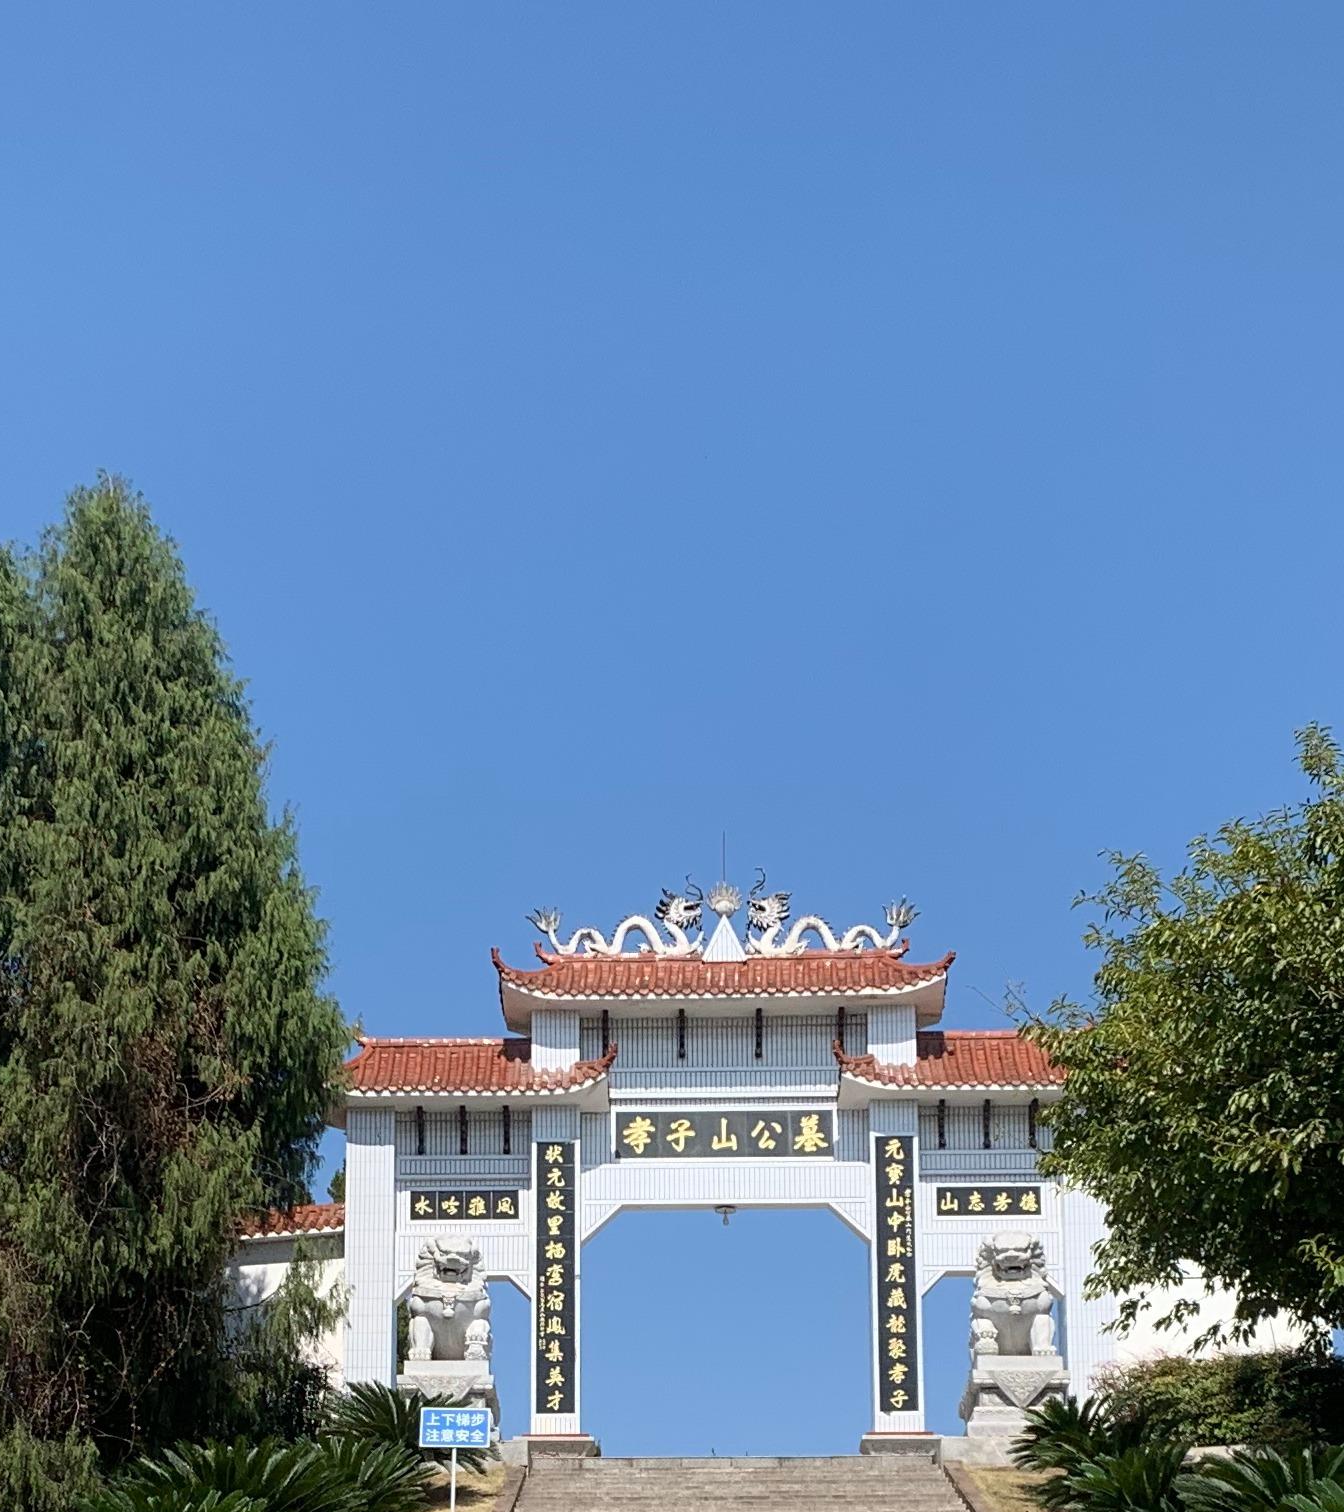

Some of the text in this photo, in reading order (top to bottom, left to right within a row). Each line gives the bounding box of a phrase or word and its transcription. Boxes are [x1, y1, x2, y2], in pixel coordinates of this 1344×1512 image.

[622, 1114, 829, 1154] 孝子山公墓
[425, 1412, 486, 1427] 上下梯步
[425, 1429, 486, 1443] 注意安全
